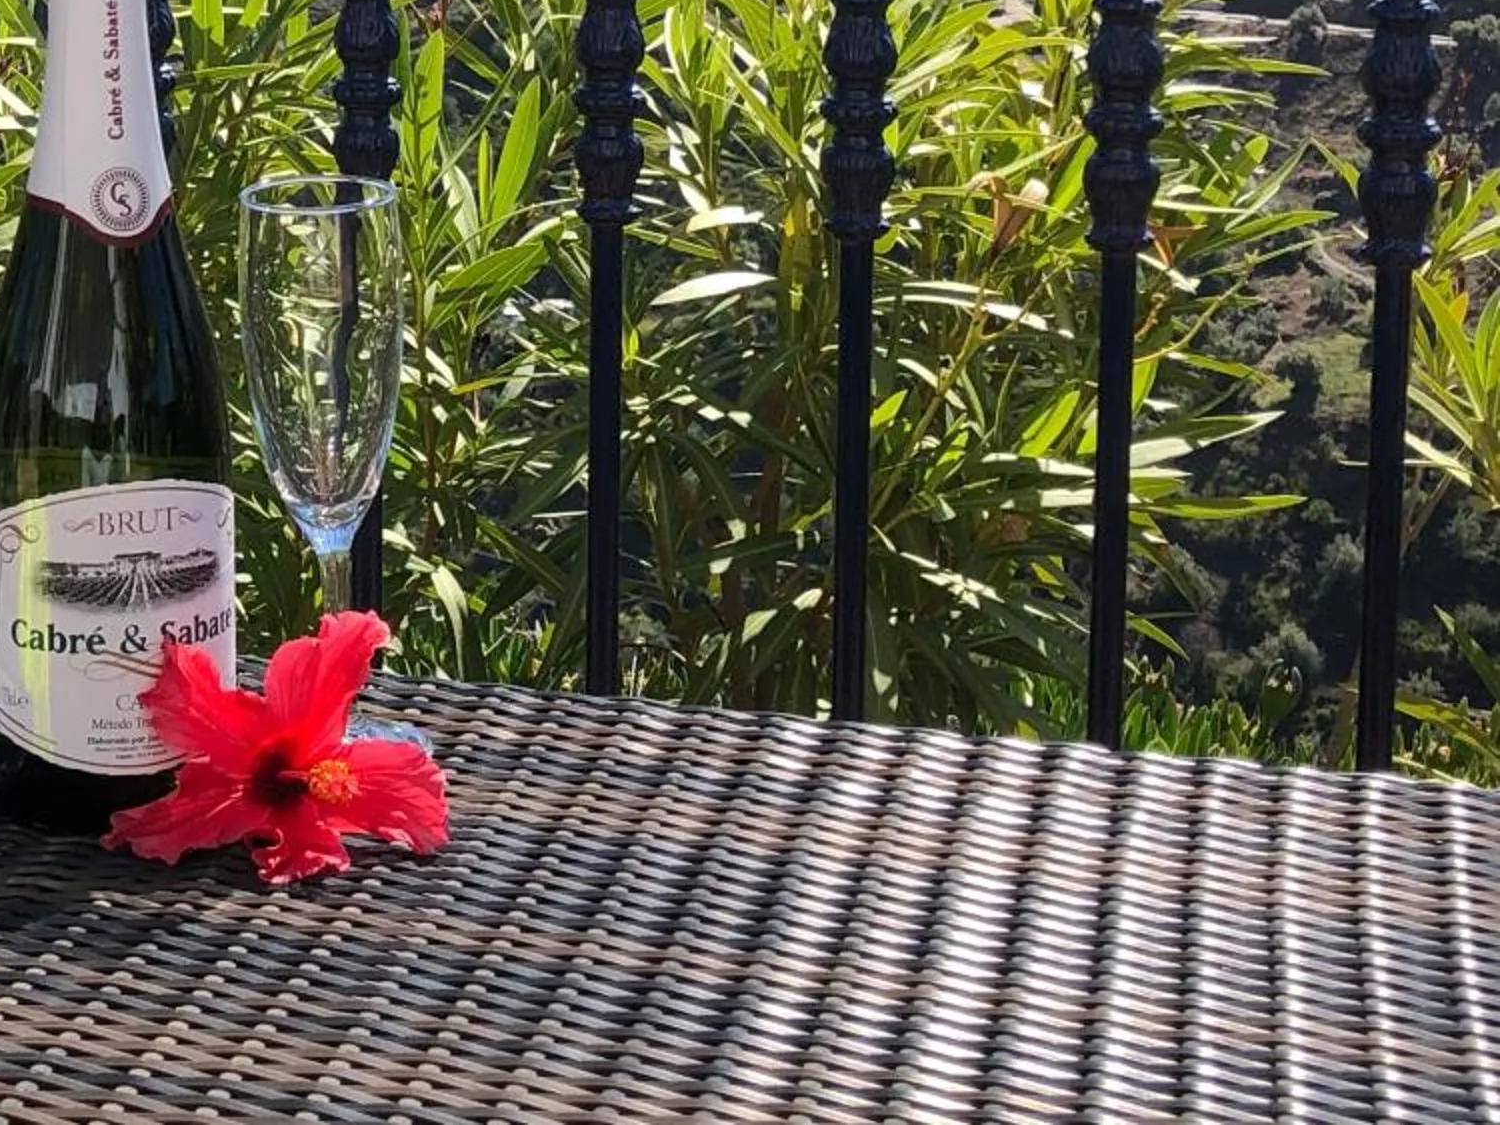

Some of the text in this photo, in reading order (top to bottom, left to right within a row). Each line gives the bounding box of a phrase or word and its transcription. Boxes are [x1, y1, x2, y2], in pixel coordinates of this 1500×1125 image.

[104, 64, 121, 82] &
[107, 86, 125, 141] Cabré
[99, 506, 179, 537] BRUT
[10, 618, 106, 656] Cabré
[119, 624, 148, 654] &
